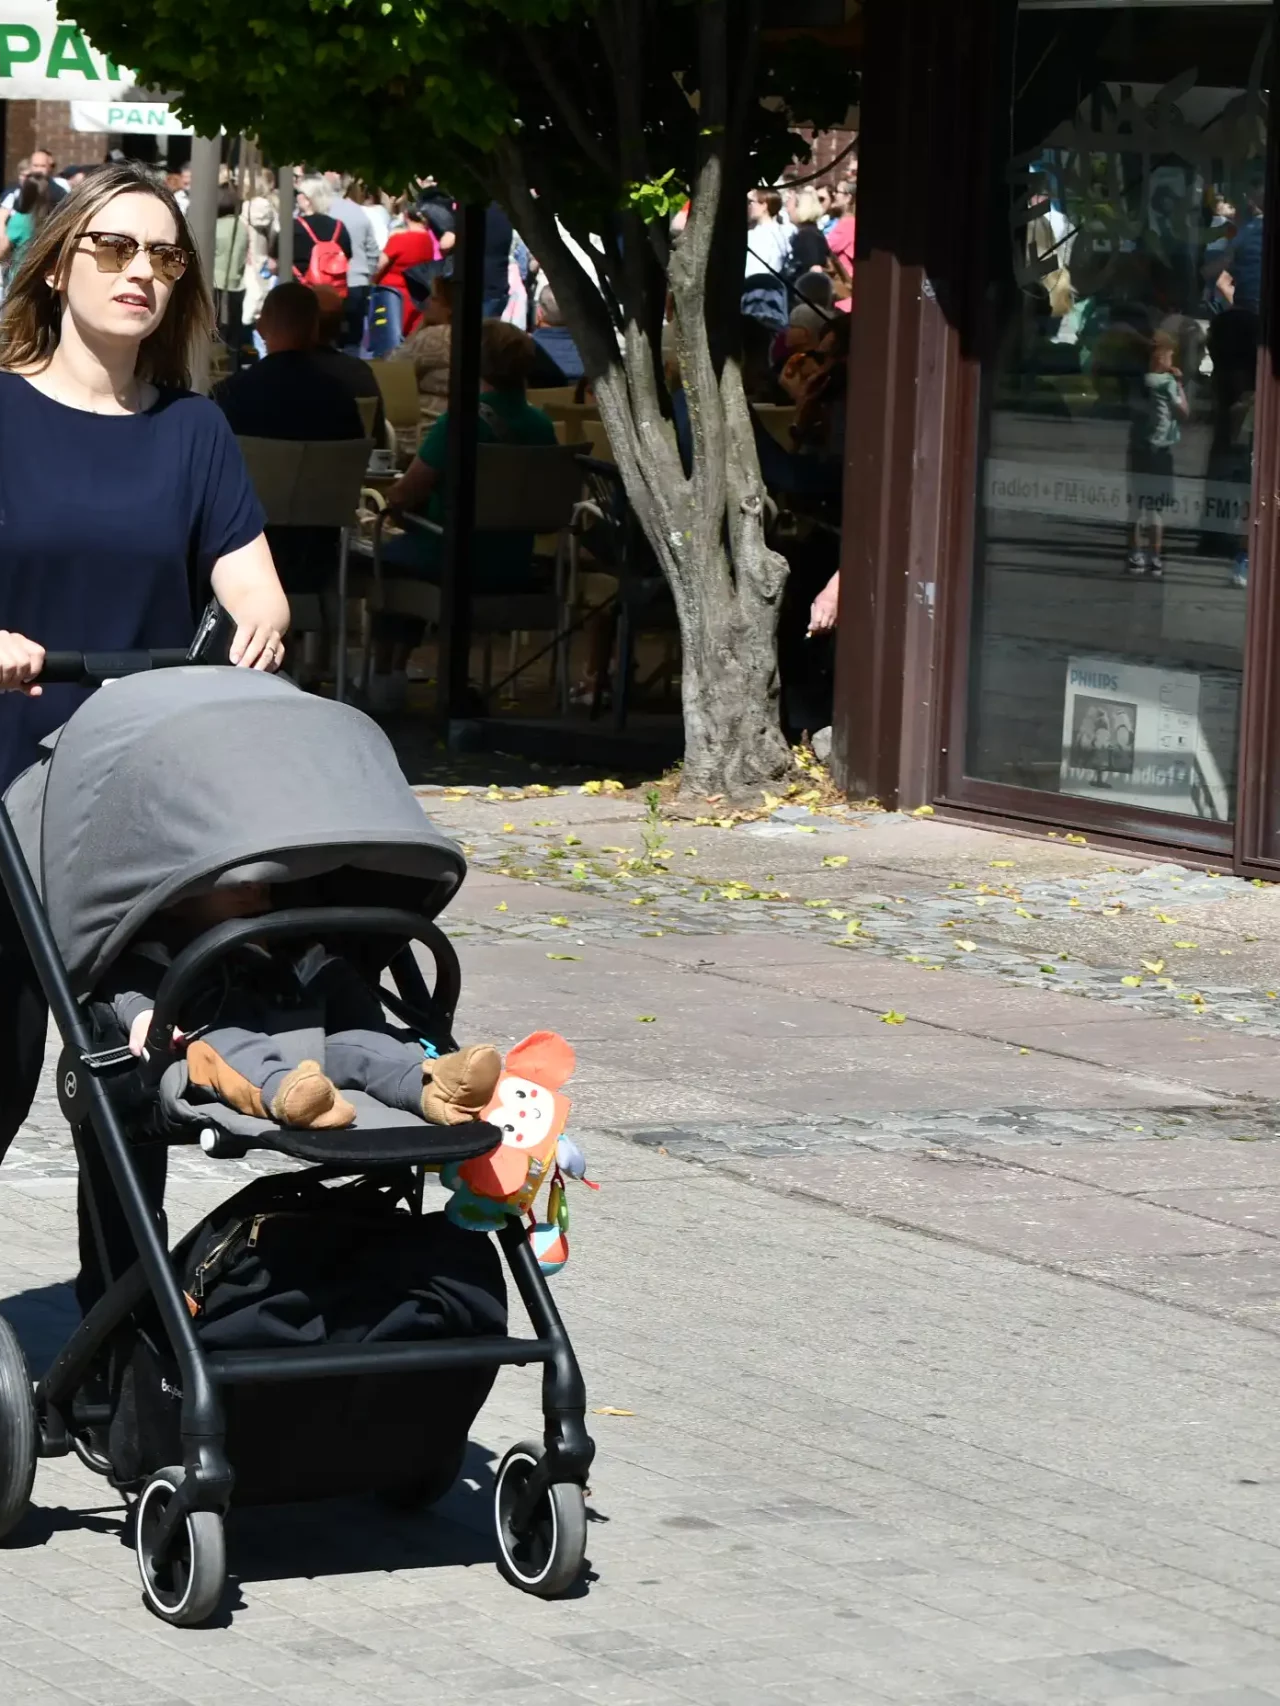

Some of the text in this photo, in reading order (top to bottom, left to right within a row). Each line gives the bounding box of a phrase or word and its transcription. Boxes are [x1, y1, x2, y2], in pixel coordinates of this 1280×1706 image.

[107, 108, 166, 126] PAN
[991, 479, 1040, 499] radio1
[1137, 492, 1189, 515] radio1
[1070, 669, 1119, 691] PHILIPS
